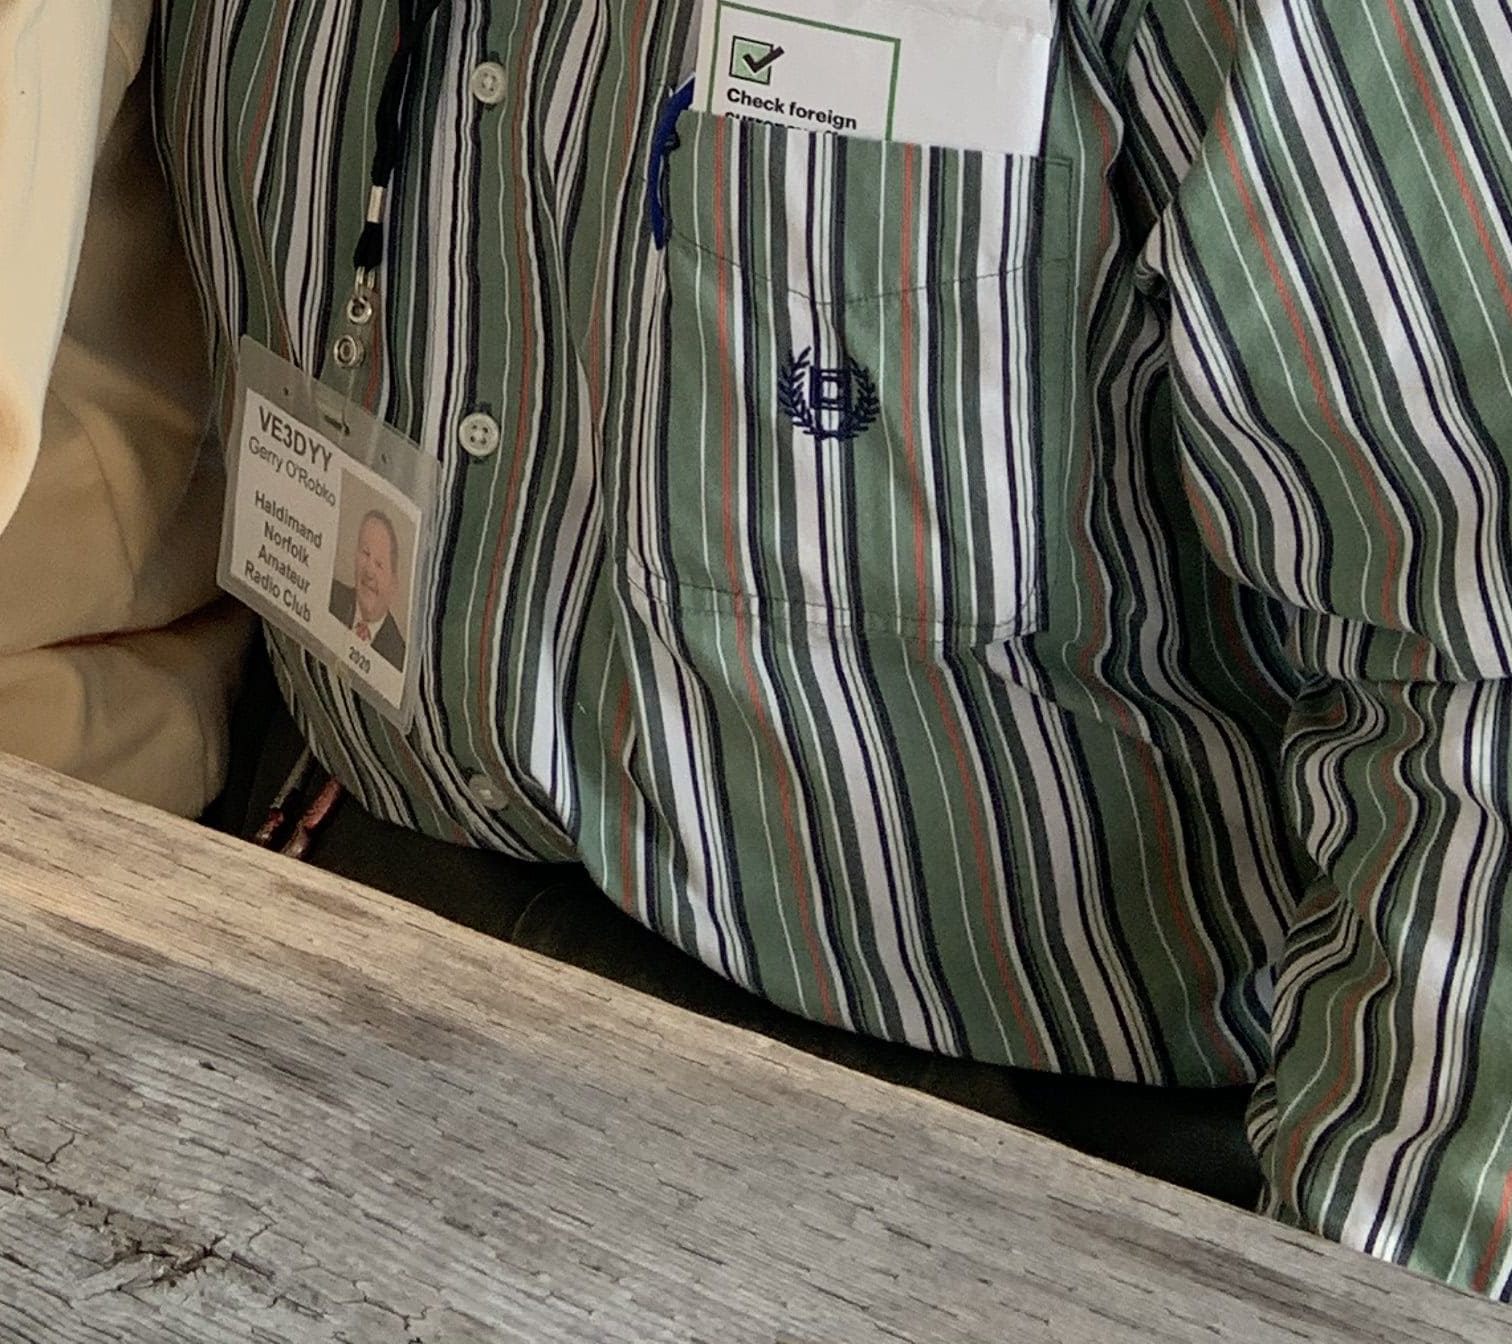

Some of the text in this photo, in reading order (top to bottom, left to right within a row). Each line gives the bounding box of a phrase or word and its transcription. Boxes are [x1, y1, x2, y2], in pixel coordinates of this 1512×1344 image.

[727, 87, 785, 114] Check
[789, 101, 857, 130] foreign
[248, 436, 284, 472] Gerry
[258, 405, 333, 472] VE3DYY
[254, 489, 322, 548] Haldimand
[264, 521, 309, 567] Norfolk
[244, 560, 311, 622] Radio Club
[258, 545, 311, 594] Amateur
[349, 646, 371, 674] 2020
